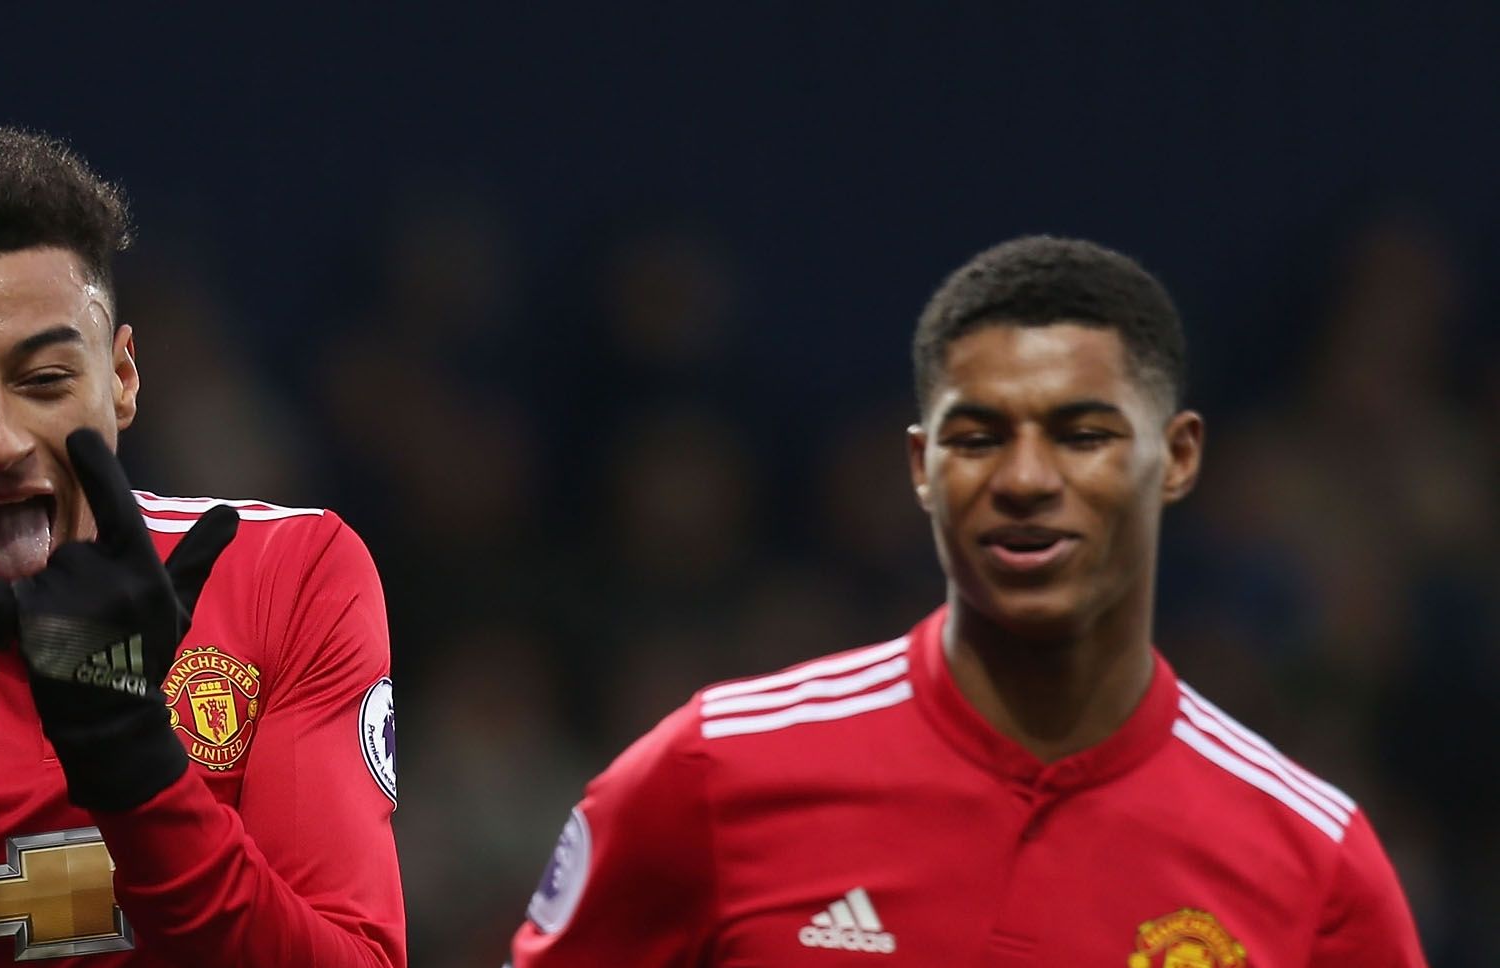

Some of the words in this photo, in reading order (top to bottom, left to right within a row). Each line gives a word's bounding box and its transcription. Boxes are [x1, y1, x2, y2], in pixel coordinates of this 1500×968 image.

[164, 656, 253, 697] MANCHESTER
[191, 739, 243, 761] UNITED
[798, 926, 896, 954] adidas
